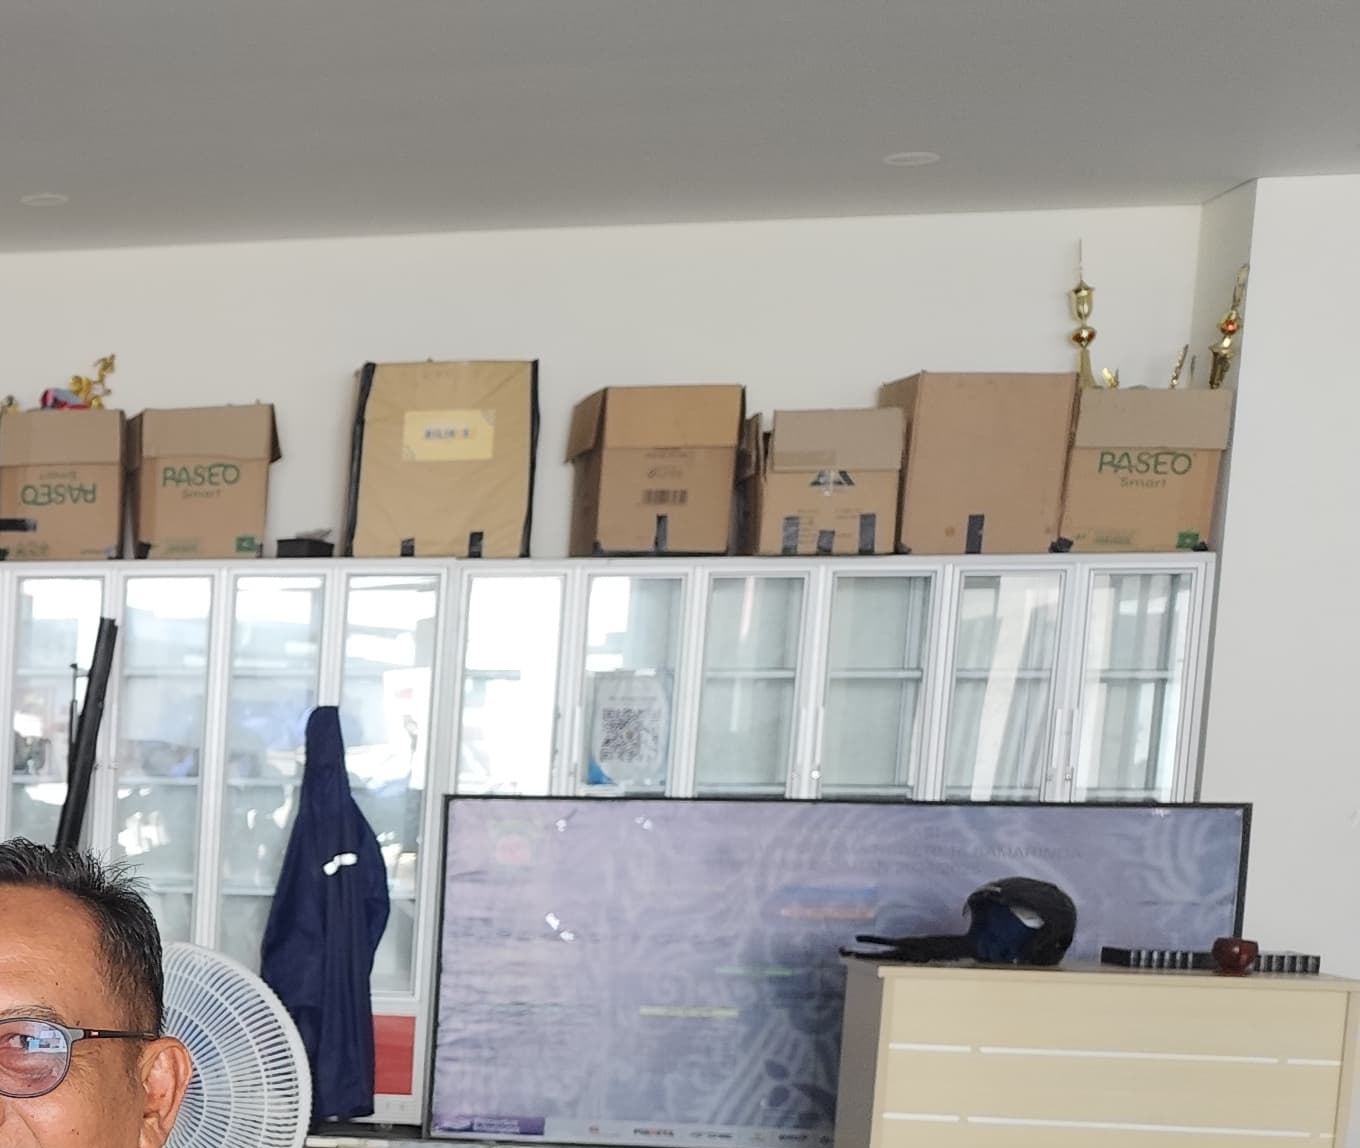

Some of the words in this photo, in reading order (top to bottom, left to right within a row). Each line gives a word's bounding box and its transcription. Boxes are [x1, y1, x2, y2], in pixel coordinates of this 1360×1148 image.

[1098, 450, 1193, 475] PASEO
[161, 463, 240, 488] PASEO
[1120, 477, 1167, 488] Smart
[20, 483, 97, 507] PASEO
